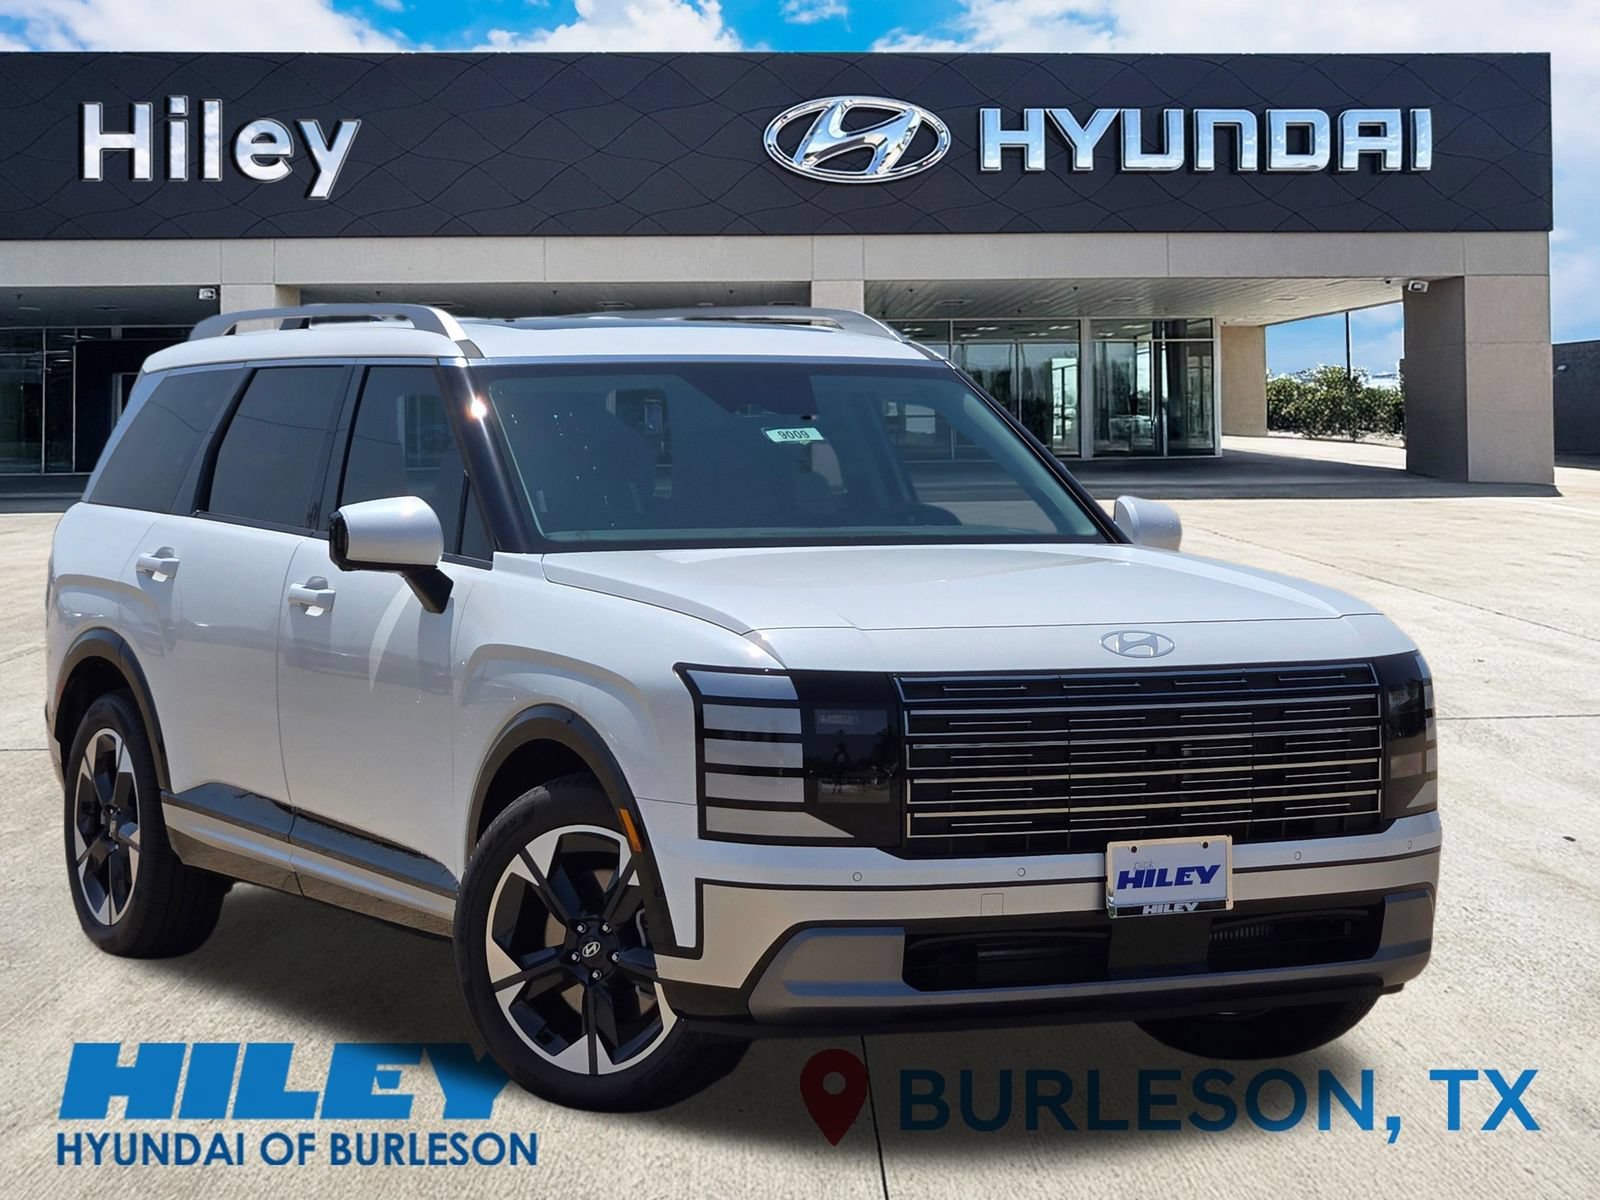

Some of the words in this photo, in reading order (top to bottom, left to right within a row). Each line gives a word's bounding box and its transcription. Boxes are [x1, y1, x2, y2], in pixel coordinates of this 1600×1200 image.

[79, 95, 361, 200] Hiley
[979, 107, 1433, 172] HYUNDAI
[777, 430, 810, 440] 9009
[1117, 864, 1221, 889] HILEY
[1142, 902, 1199, 914] HILEY
